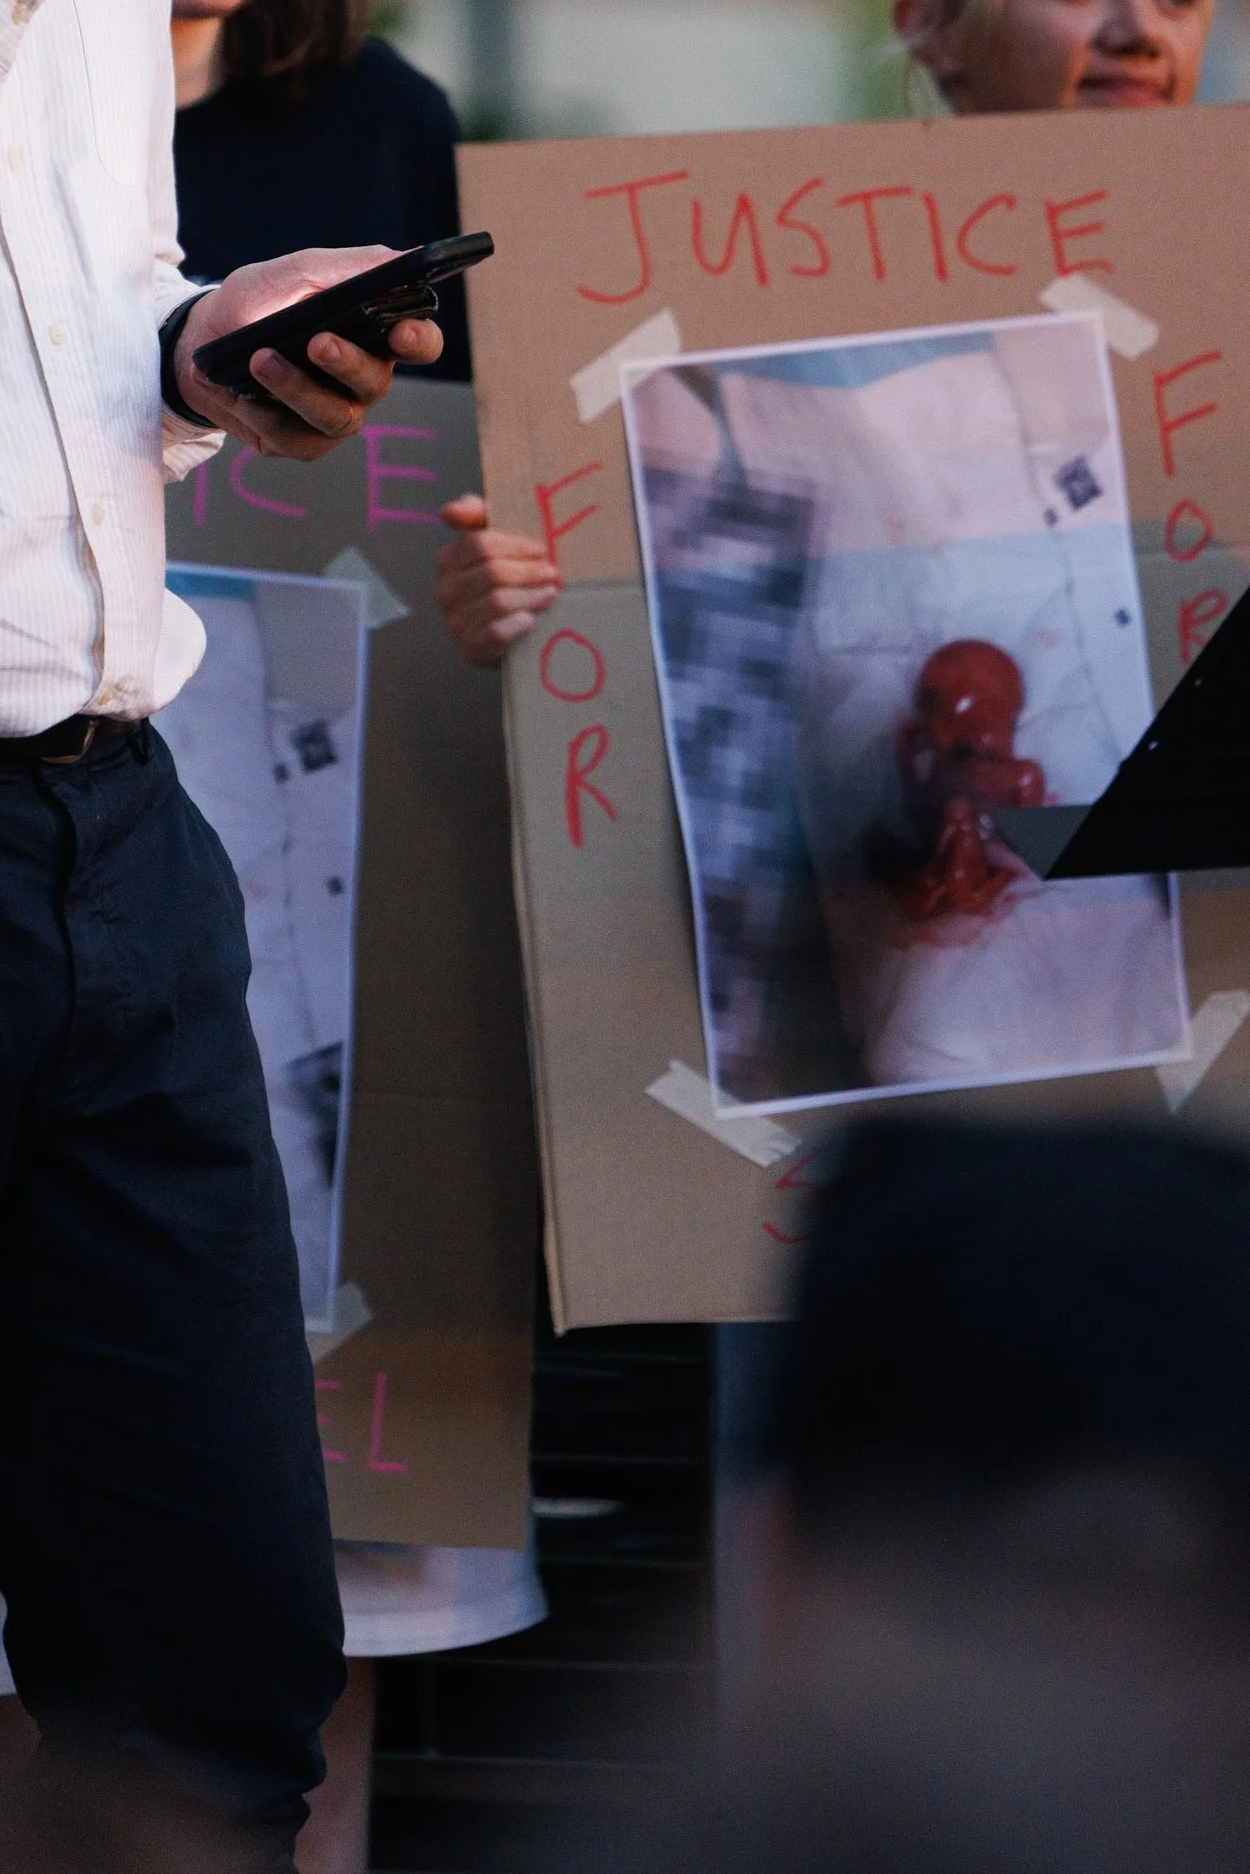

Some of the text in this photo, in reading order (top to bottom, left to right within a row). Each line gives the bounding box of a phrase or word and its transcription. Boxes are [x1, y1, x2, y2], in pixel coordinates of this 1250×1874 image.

[576, 170, 1116, 305] JUSTICE
[192, 424, 447, 534] ICE
[1152, 329, 1228, 668] FOR
[535, 460, 619, 849] FOR
